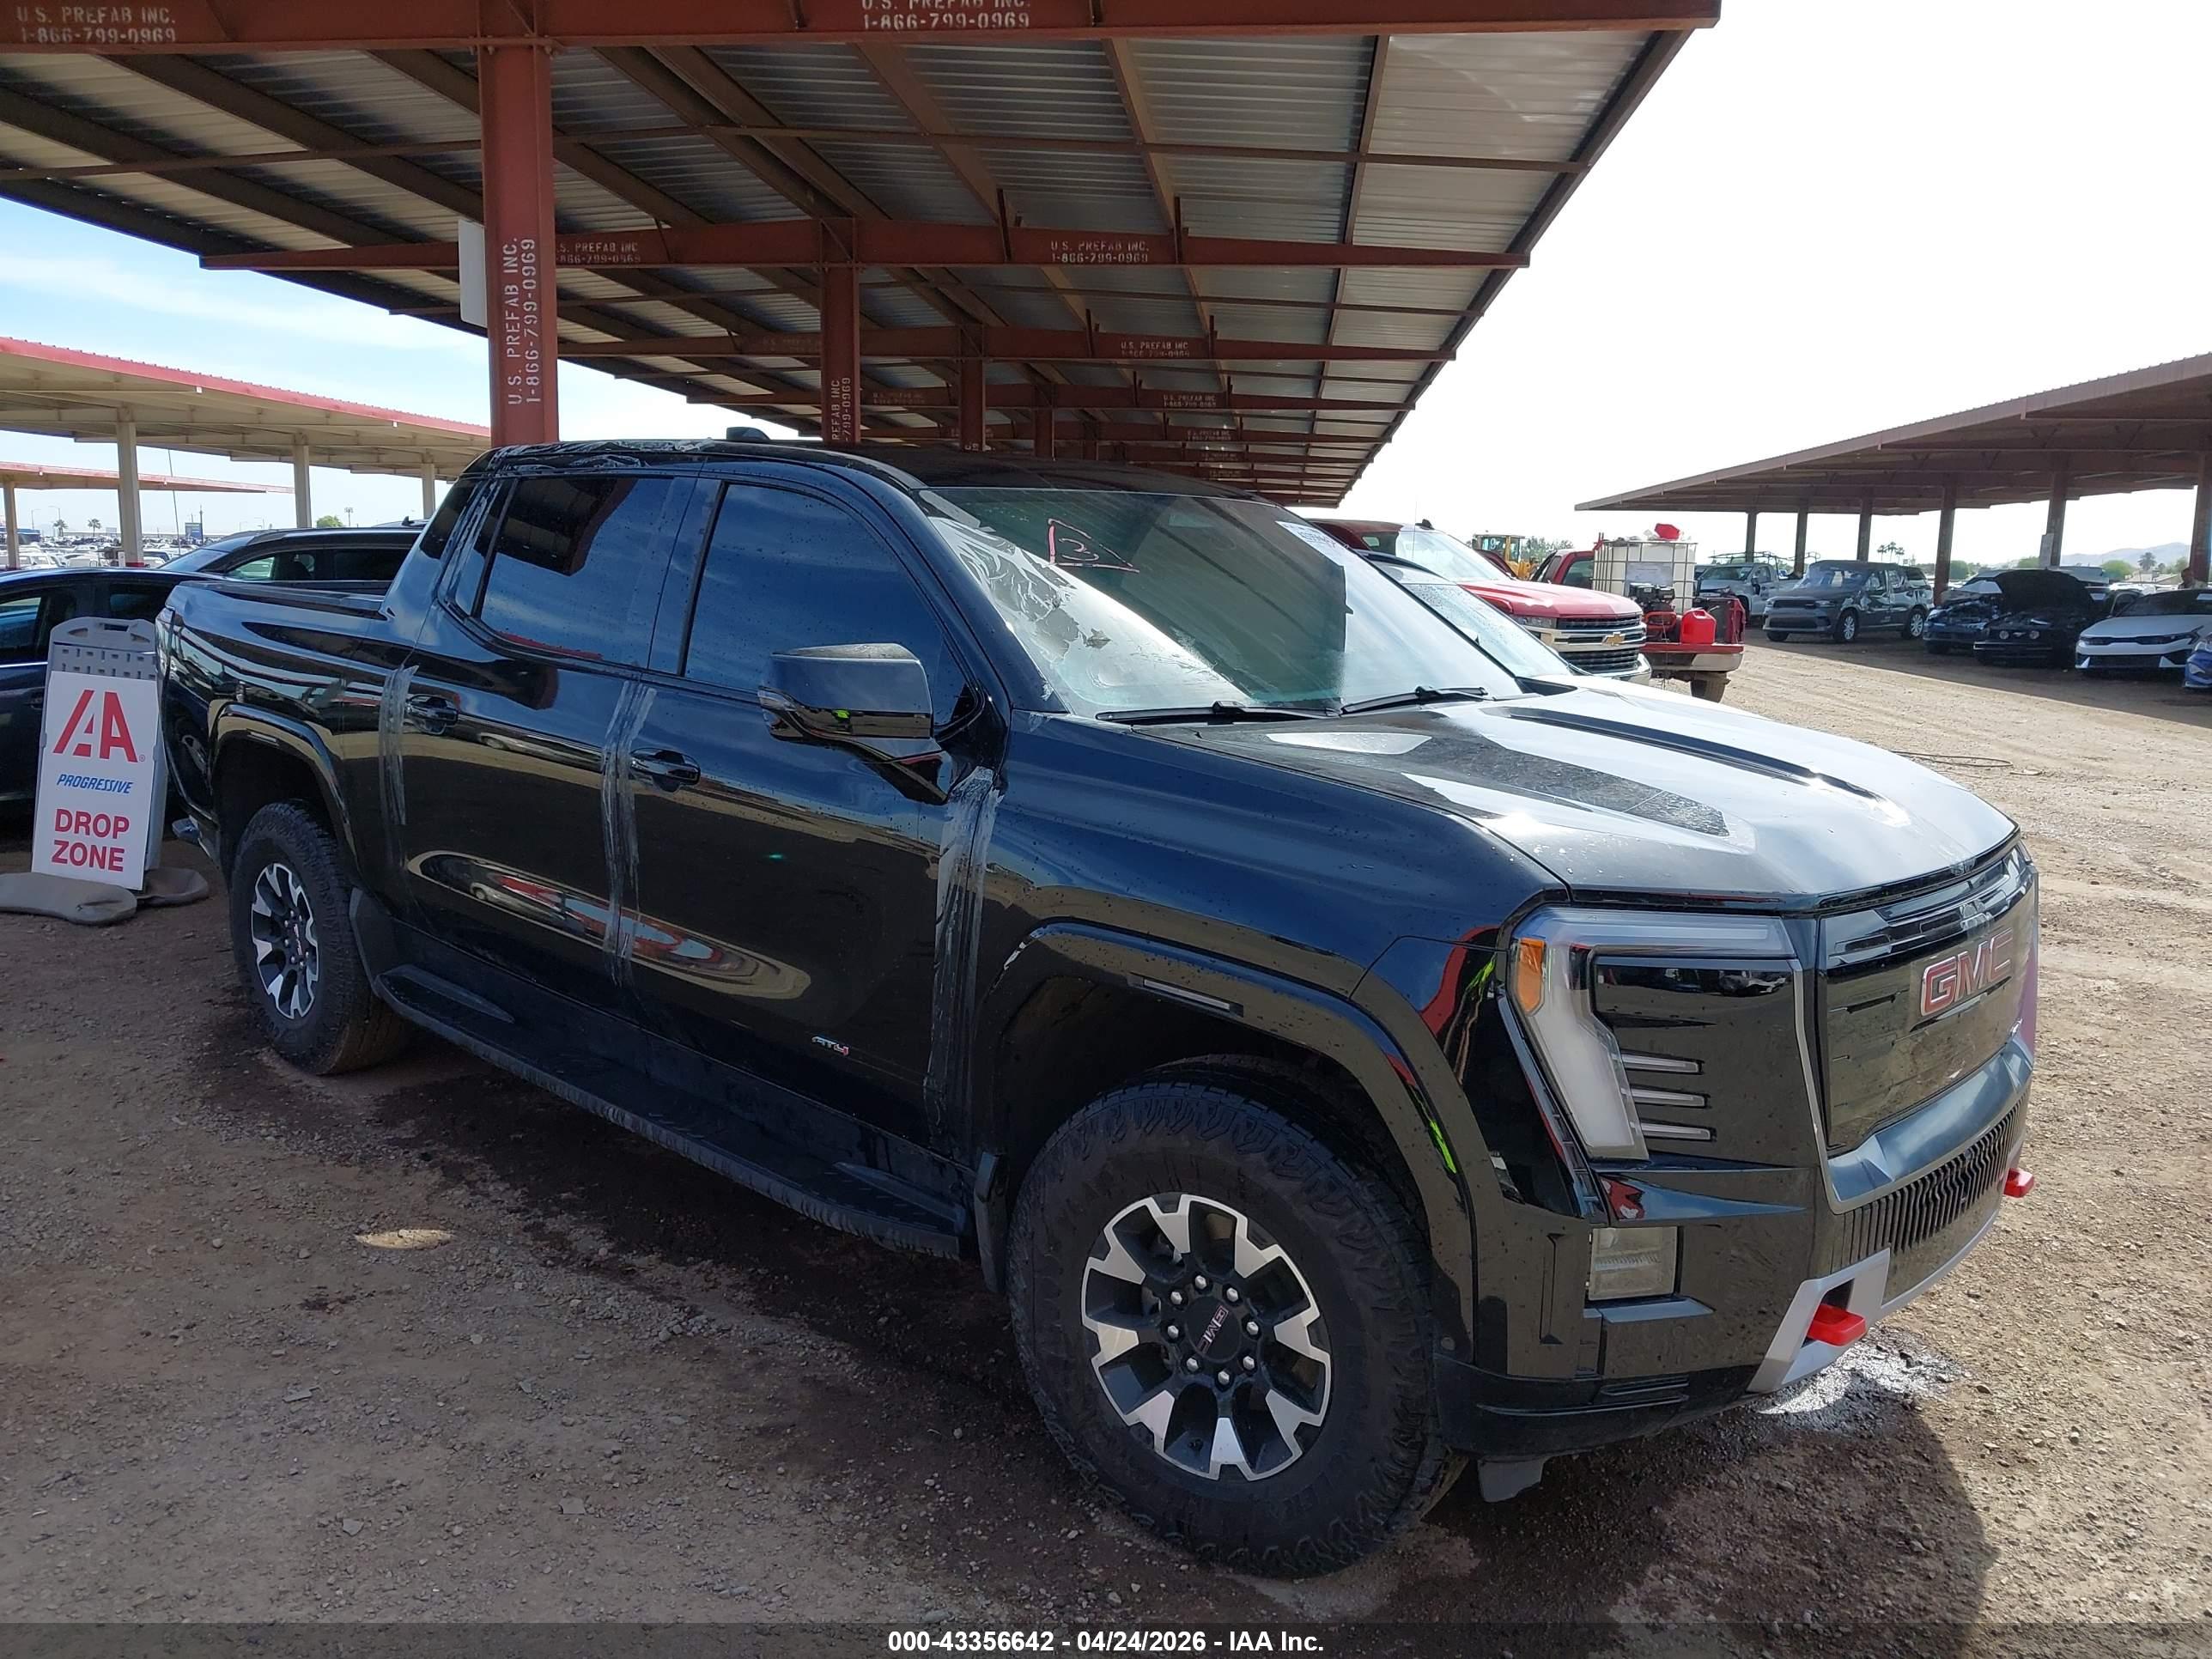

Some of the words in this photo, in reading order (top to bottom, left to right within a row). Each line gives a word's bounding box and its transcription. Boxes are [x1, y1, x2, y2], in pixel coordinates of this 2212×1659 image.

[61, 7, 132, 23] PREFAB
[142, 7, 176, 23] INC.
[864, 12, 1030, 30] 1-866-799-0969
[21, 27, 176, 43] 1-866-799-0969
[502, 237, 519, 273] INC.
[575, 242, 617, 252] PREFAB
[1078, 240, 1121, 252] PREFAB
[1127, 240, 1149, 252] INC.
[1052, 253, 1148, 263] 1-866-799-0969
[505, 284, 521, 357] PREFAB
[520, 238, 541, 403] 1-866-799-0969
[1140, 341, 1171, 350] PREFAB
[508, 369, 522, 404] U.S.
[57, 774, 133, 794] PROGRESSIVE
[54, 809, 130, 840] DROP
[52, 840, 125, 872] ZONE
[1920, 927, 2014, 1017] GMC
